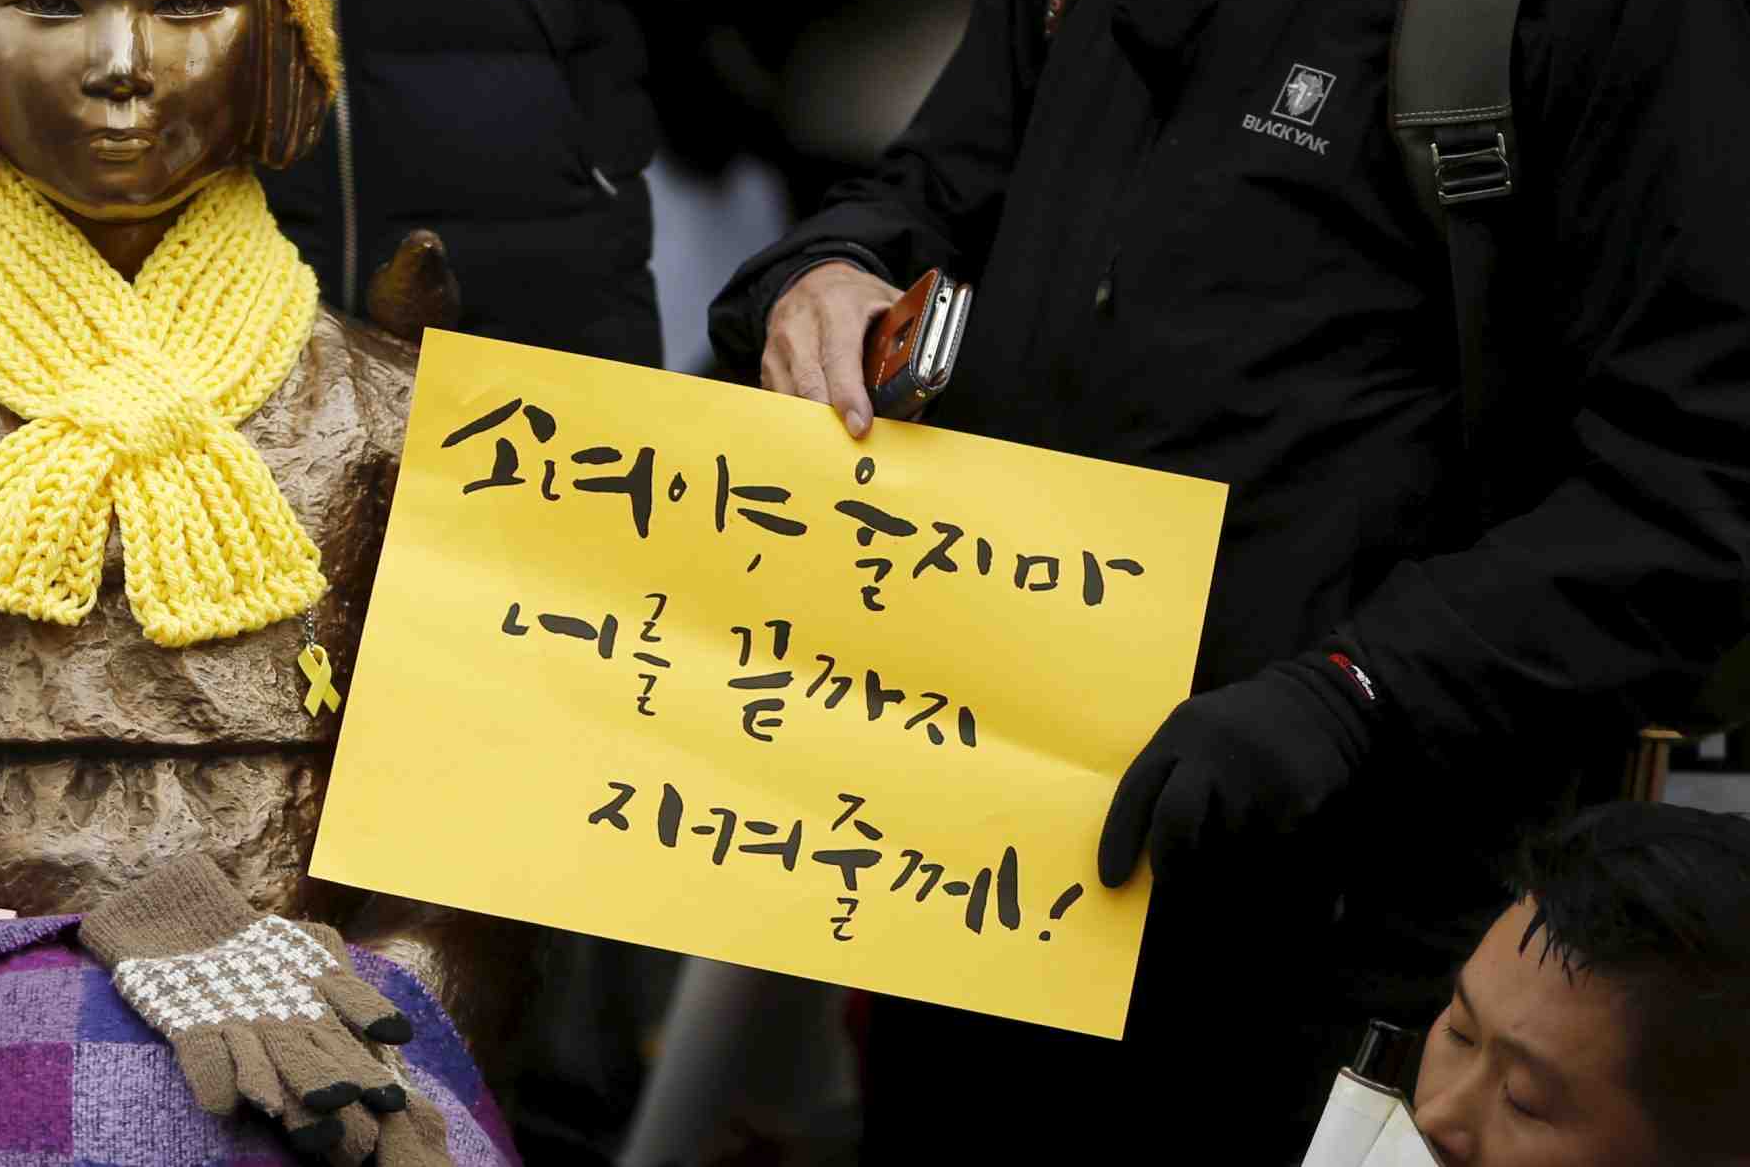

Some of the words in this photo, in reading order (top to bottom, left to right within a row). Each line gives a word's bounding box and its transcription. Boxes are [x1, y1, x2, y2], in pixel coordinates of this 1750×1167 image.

[834, 457, 1145, 612] 울지마
[502, 593, 671, 716] 너를
[728, 619, 977, 748] 끝까지
[588, 782, 1084, 942] 지켜줄께!
